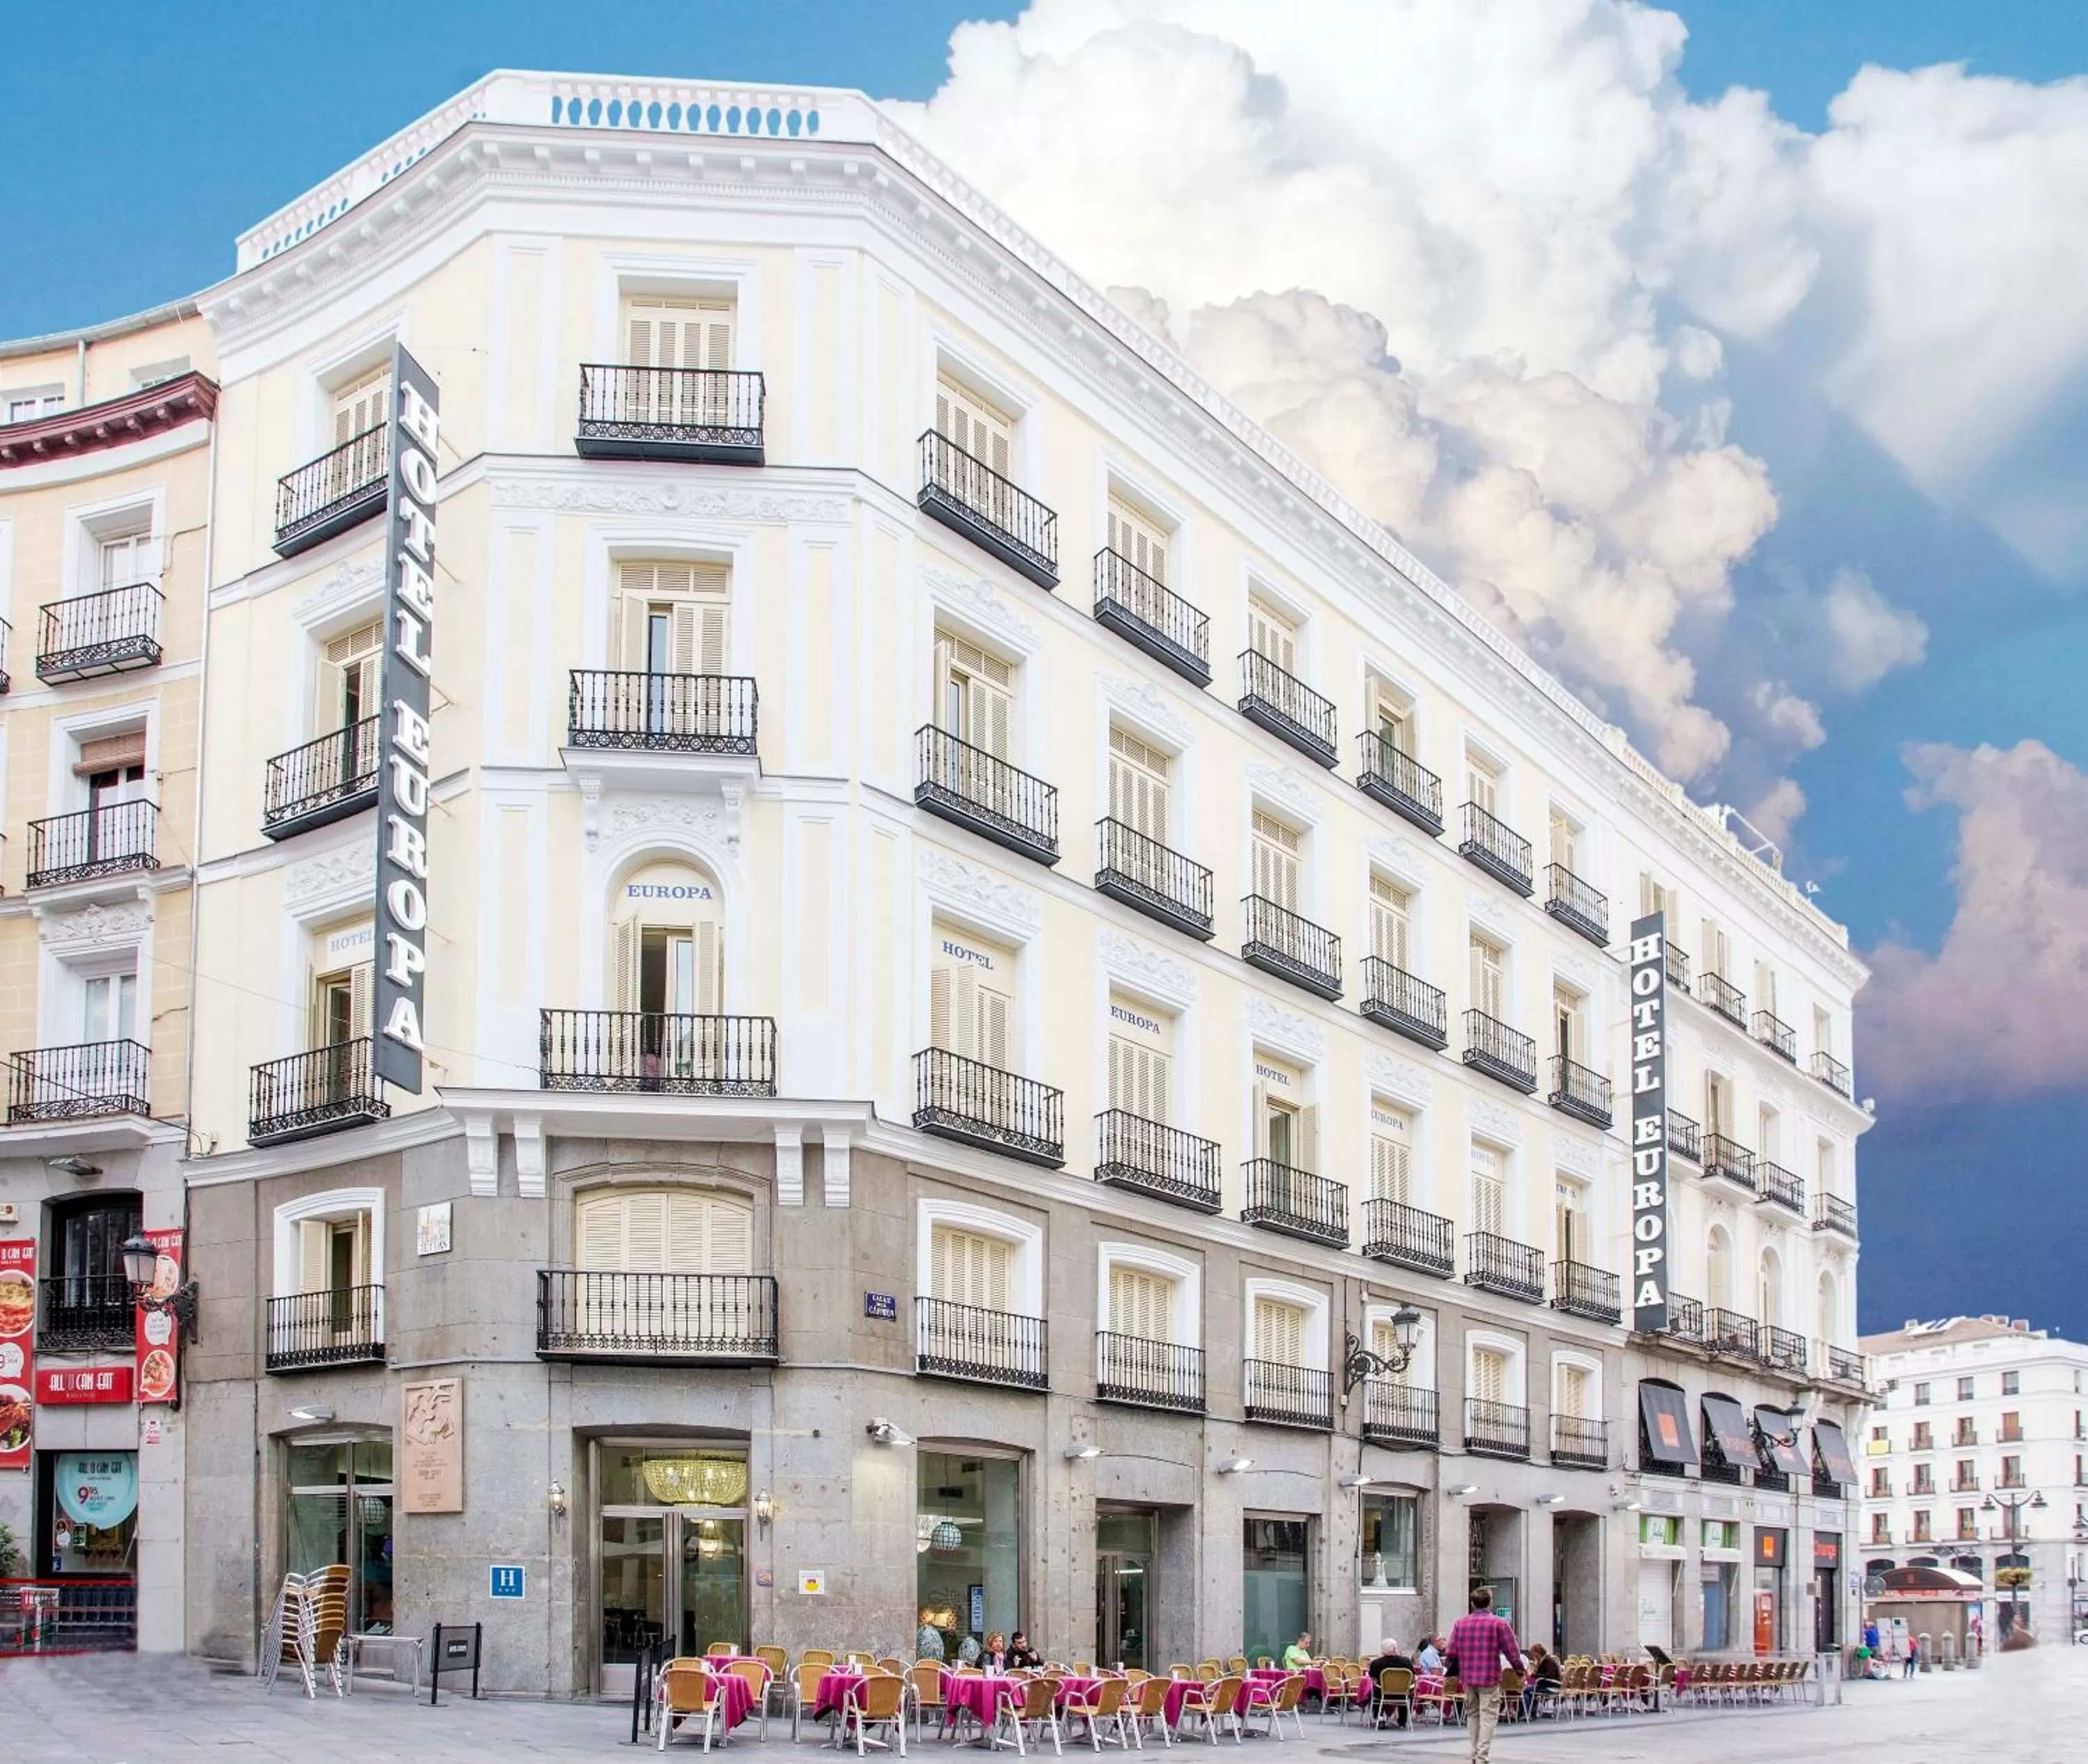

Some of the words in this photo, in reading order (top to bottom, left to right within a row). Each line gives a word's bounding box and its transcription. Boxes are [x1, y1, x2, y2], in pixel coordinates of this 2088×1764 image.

[396, 380, 440, 677] HOTEL
[382, 698, 430, 1050] EUROPA
[627, 885, 713, 900] EUROPA
[331, 929, 374, 953] HOTEL
[943, 940, 995, 970] HOTEL
[1110, 1005, 1162, 1035] EUROPA
[1629, 931, 1661, 1095] HOTEL
[1256, 1064, 1290, 1086] HOTEL
[1633, 1116, 1664, 1309] EUROPA
[49, 1373, 66, 1392] ALL
[76, 1373, 94, 1390] CAN
[97, 1372, 114, 1390] EAT
[500, 1570, 514, 1586] H
